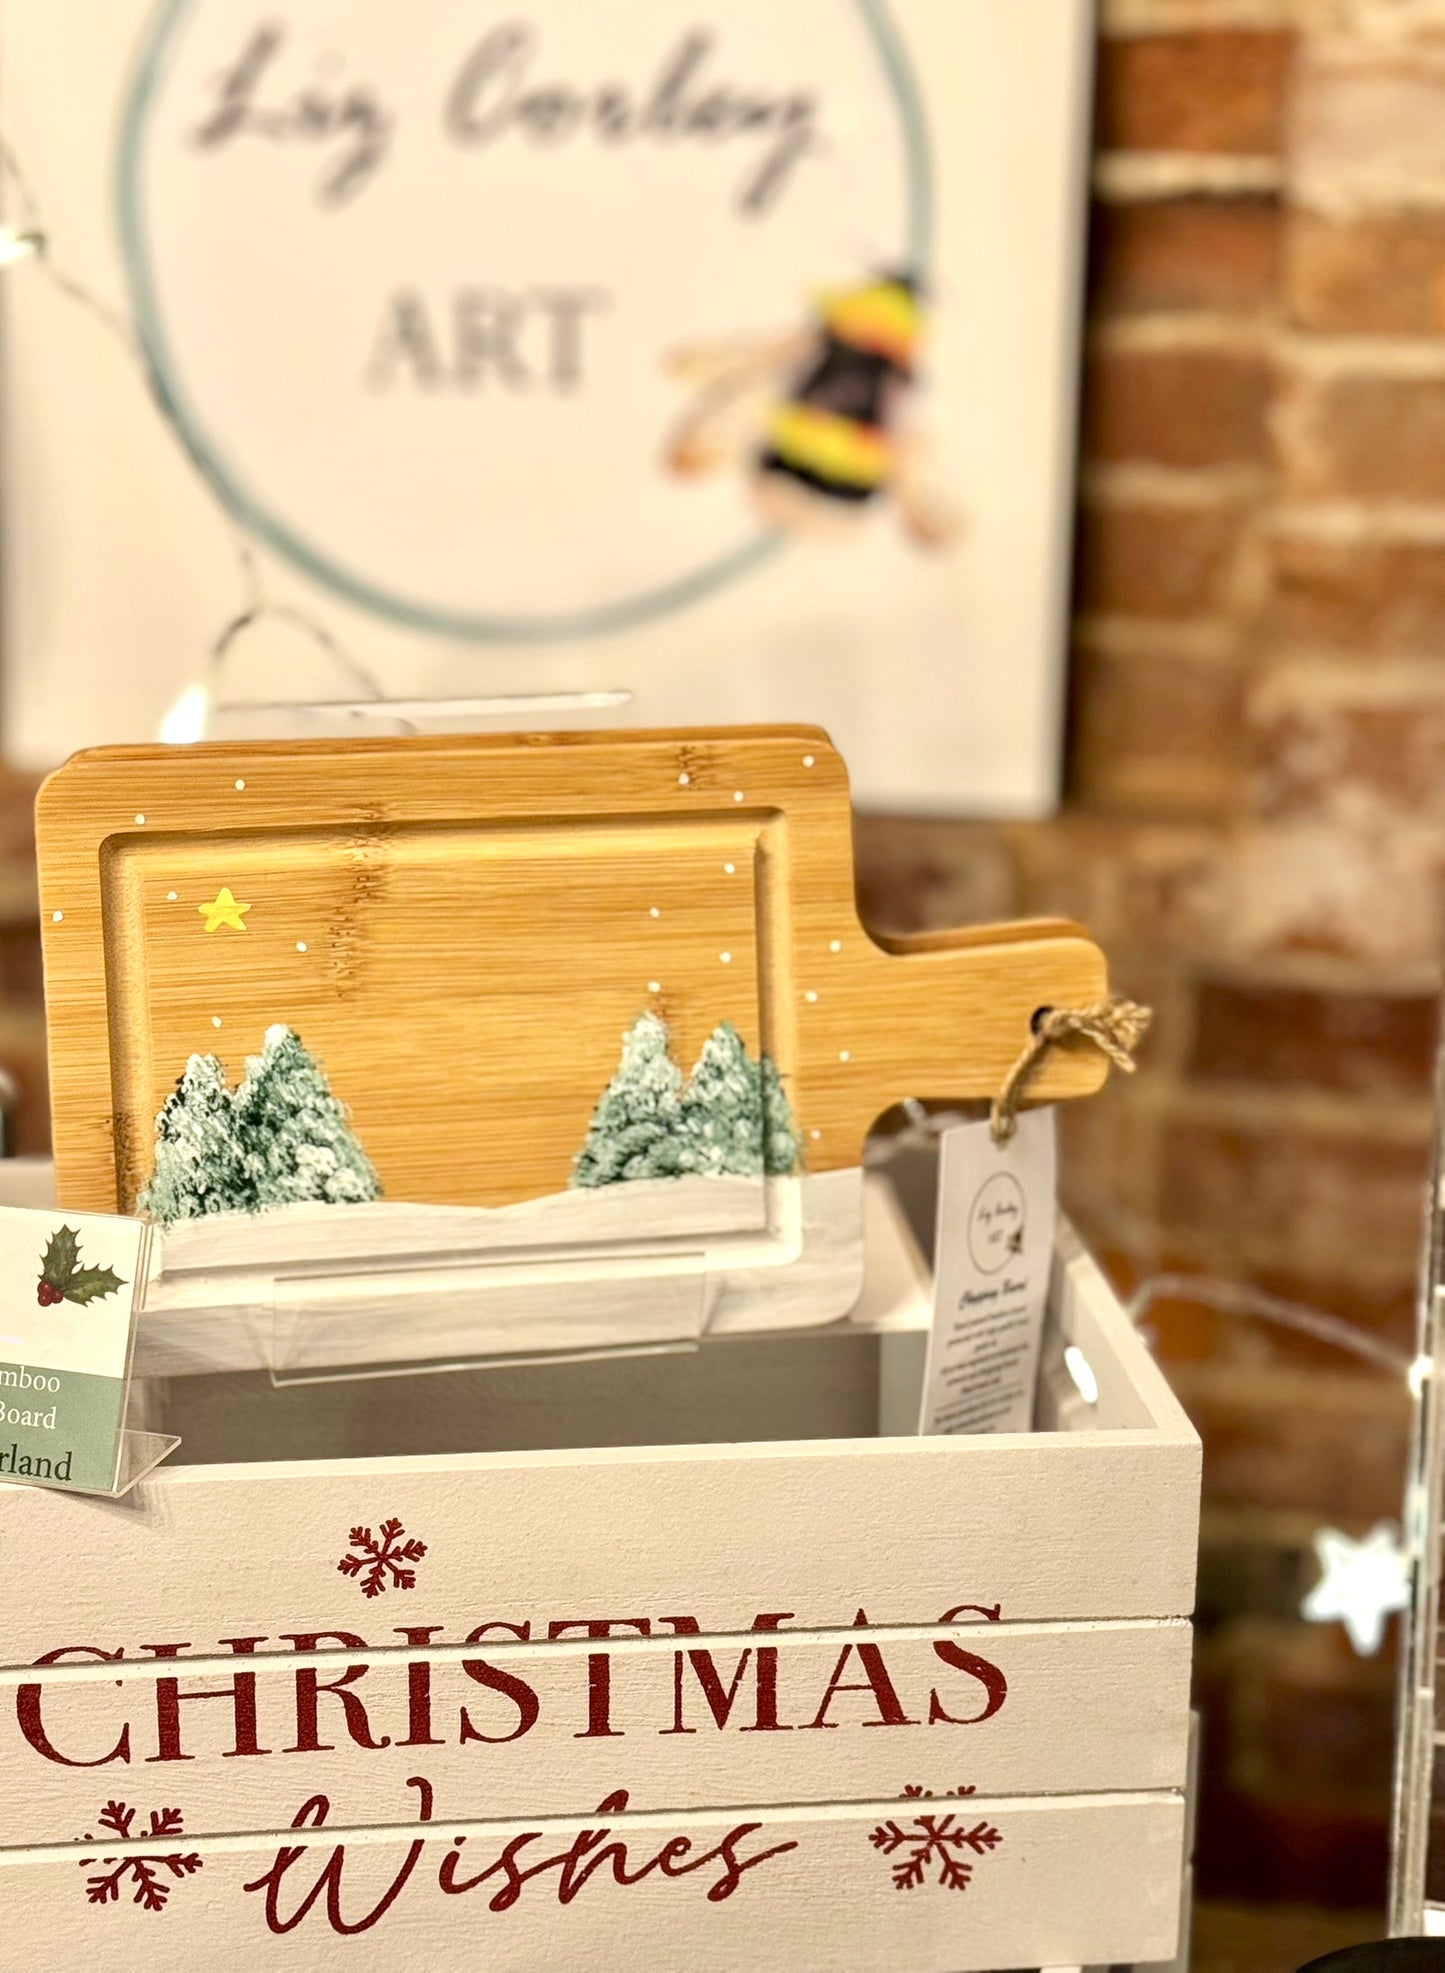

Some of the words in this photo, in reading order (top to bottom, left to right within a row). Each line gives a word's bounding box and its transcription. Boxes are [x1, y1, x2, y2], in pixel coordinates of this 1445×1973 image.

[188, 22, 393, 208] Liz
[368, 284, 606, 396] ART
[16, 1604, 1008, 1767] CHRISTMAS
[245, 1776, 799, 1934] Wishes
